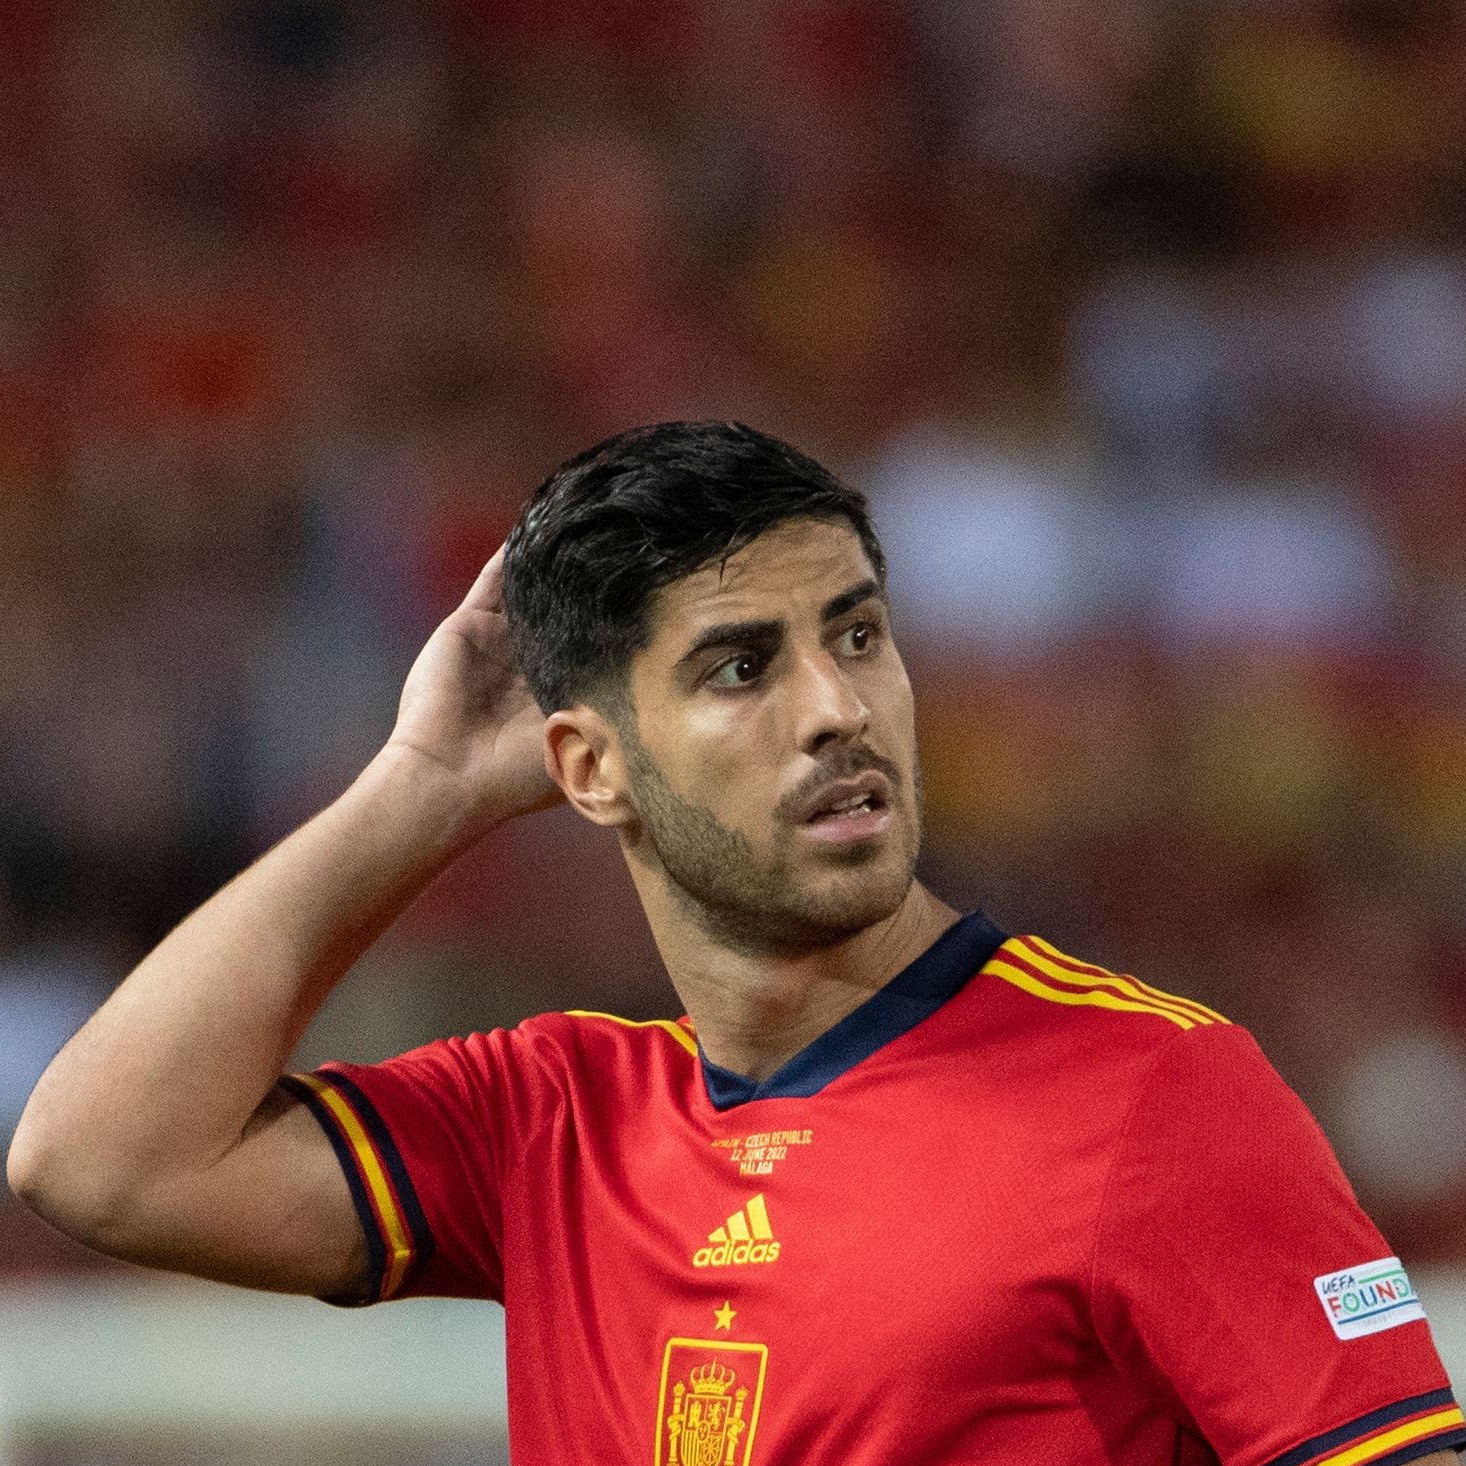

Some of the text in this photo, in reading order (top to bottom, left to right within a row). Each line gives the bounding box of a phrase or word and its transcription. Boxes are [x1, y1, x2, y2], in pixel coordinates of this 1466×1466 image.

[745, 1132, 771, 1148] CZECH
[771, 1129, 813, 1145] REPUBLIC
[731, 1146, 788, 1161] 12 JUNE 2022
[693, 1240, 781, 1268] adidas
[1321, 1275, 1356, 1294] UEFA
[1327, 1278, 1413, 1318] FOUND
